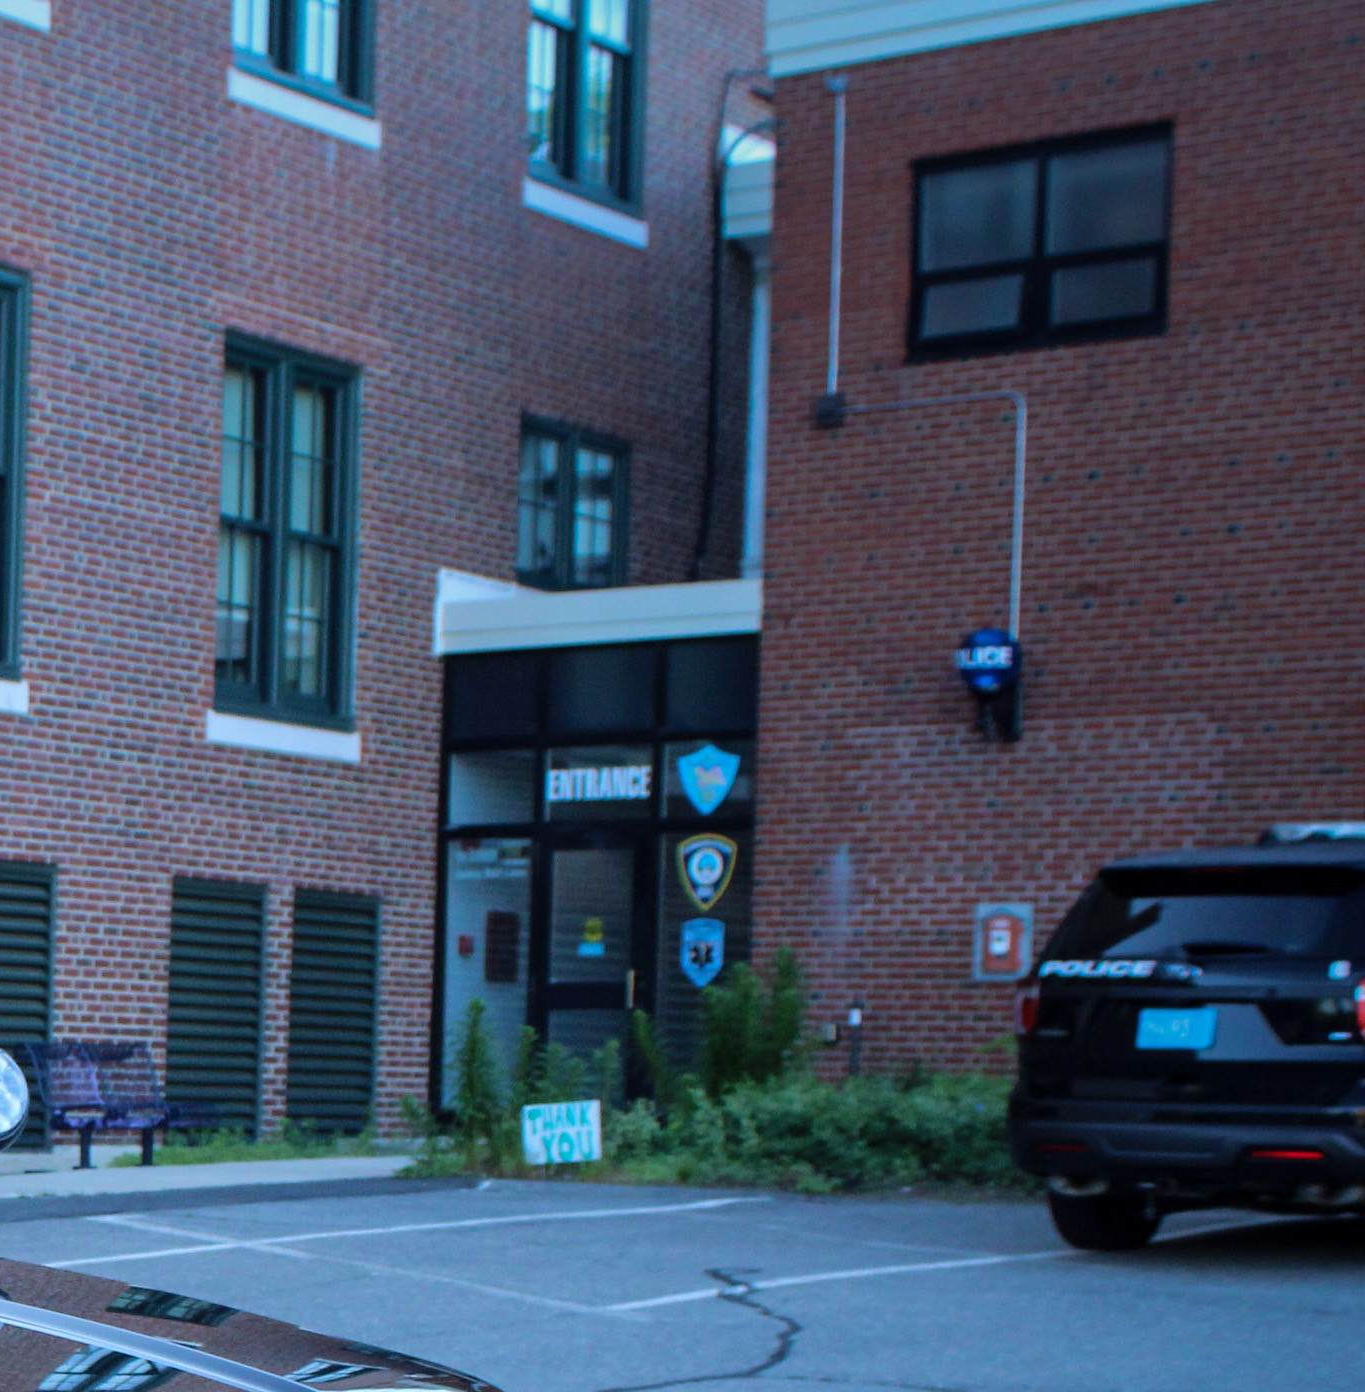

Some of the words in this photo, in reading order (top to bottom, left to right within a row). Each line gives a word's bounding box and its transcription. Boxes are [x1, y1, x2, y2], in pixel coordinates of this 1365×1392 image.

[546, 765, 651, 801] ENTRANCE
[1038, 959, 1157, 978] POLICE
[528, 1103, 592, 1135] THANK
[542, 1130, 593, 1163] YOU
